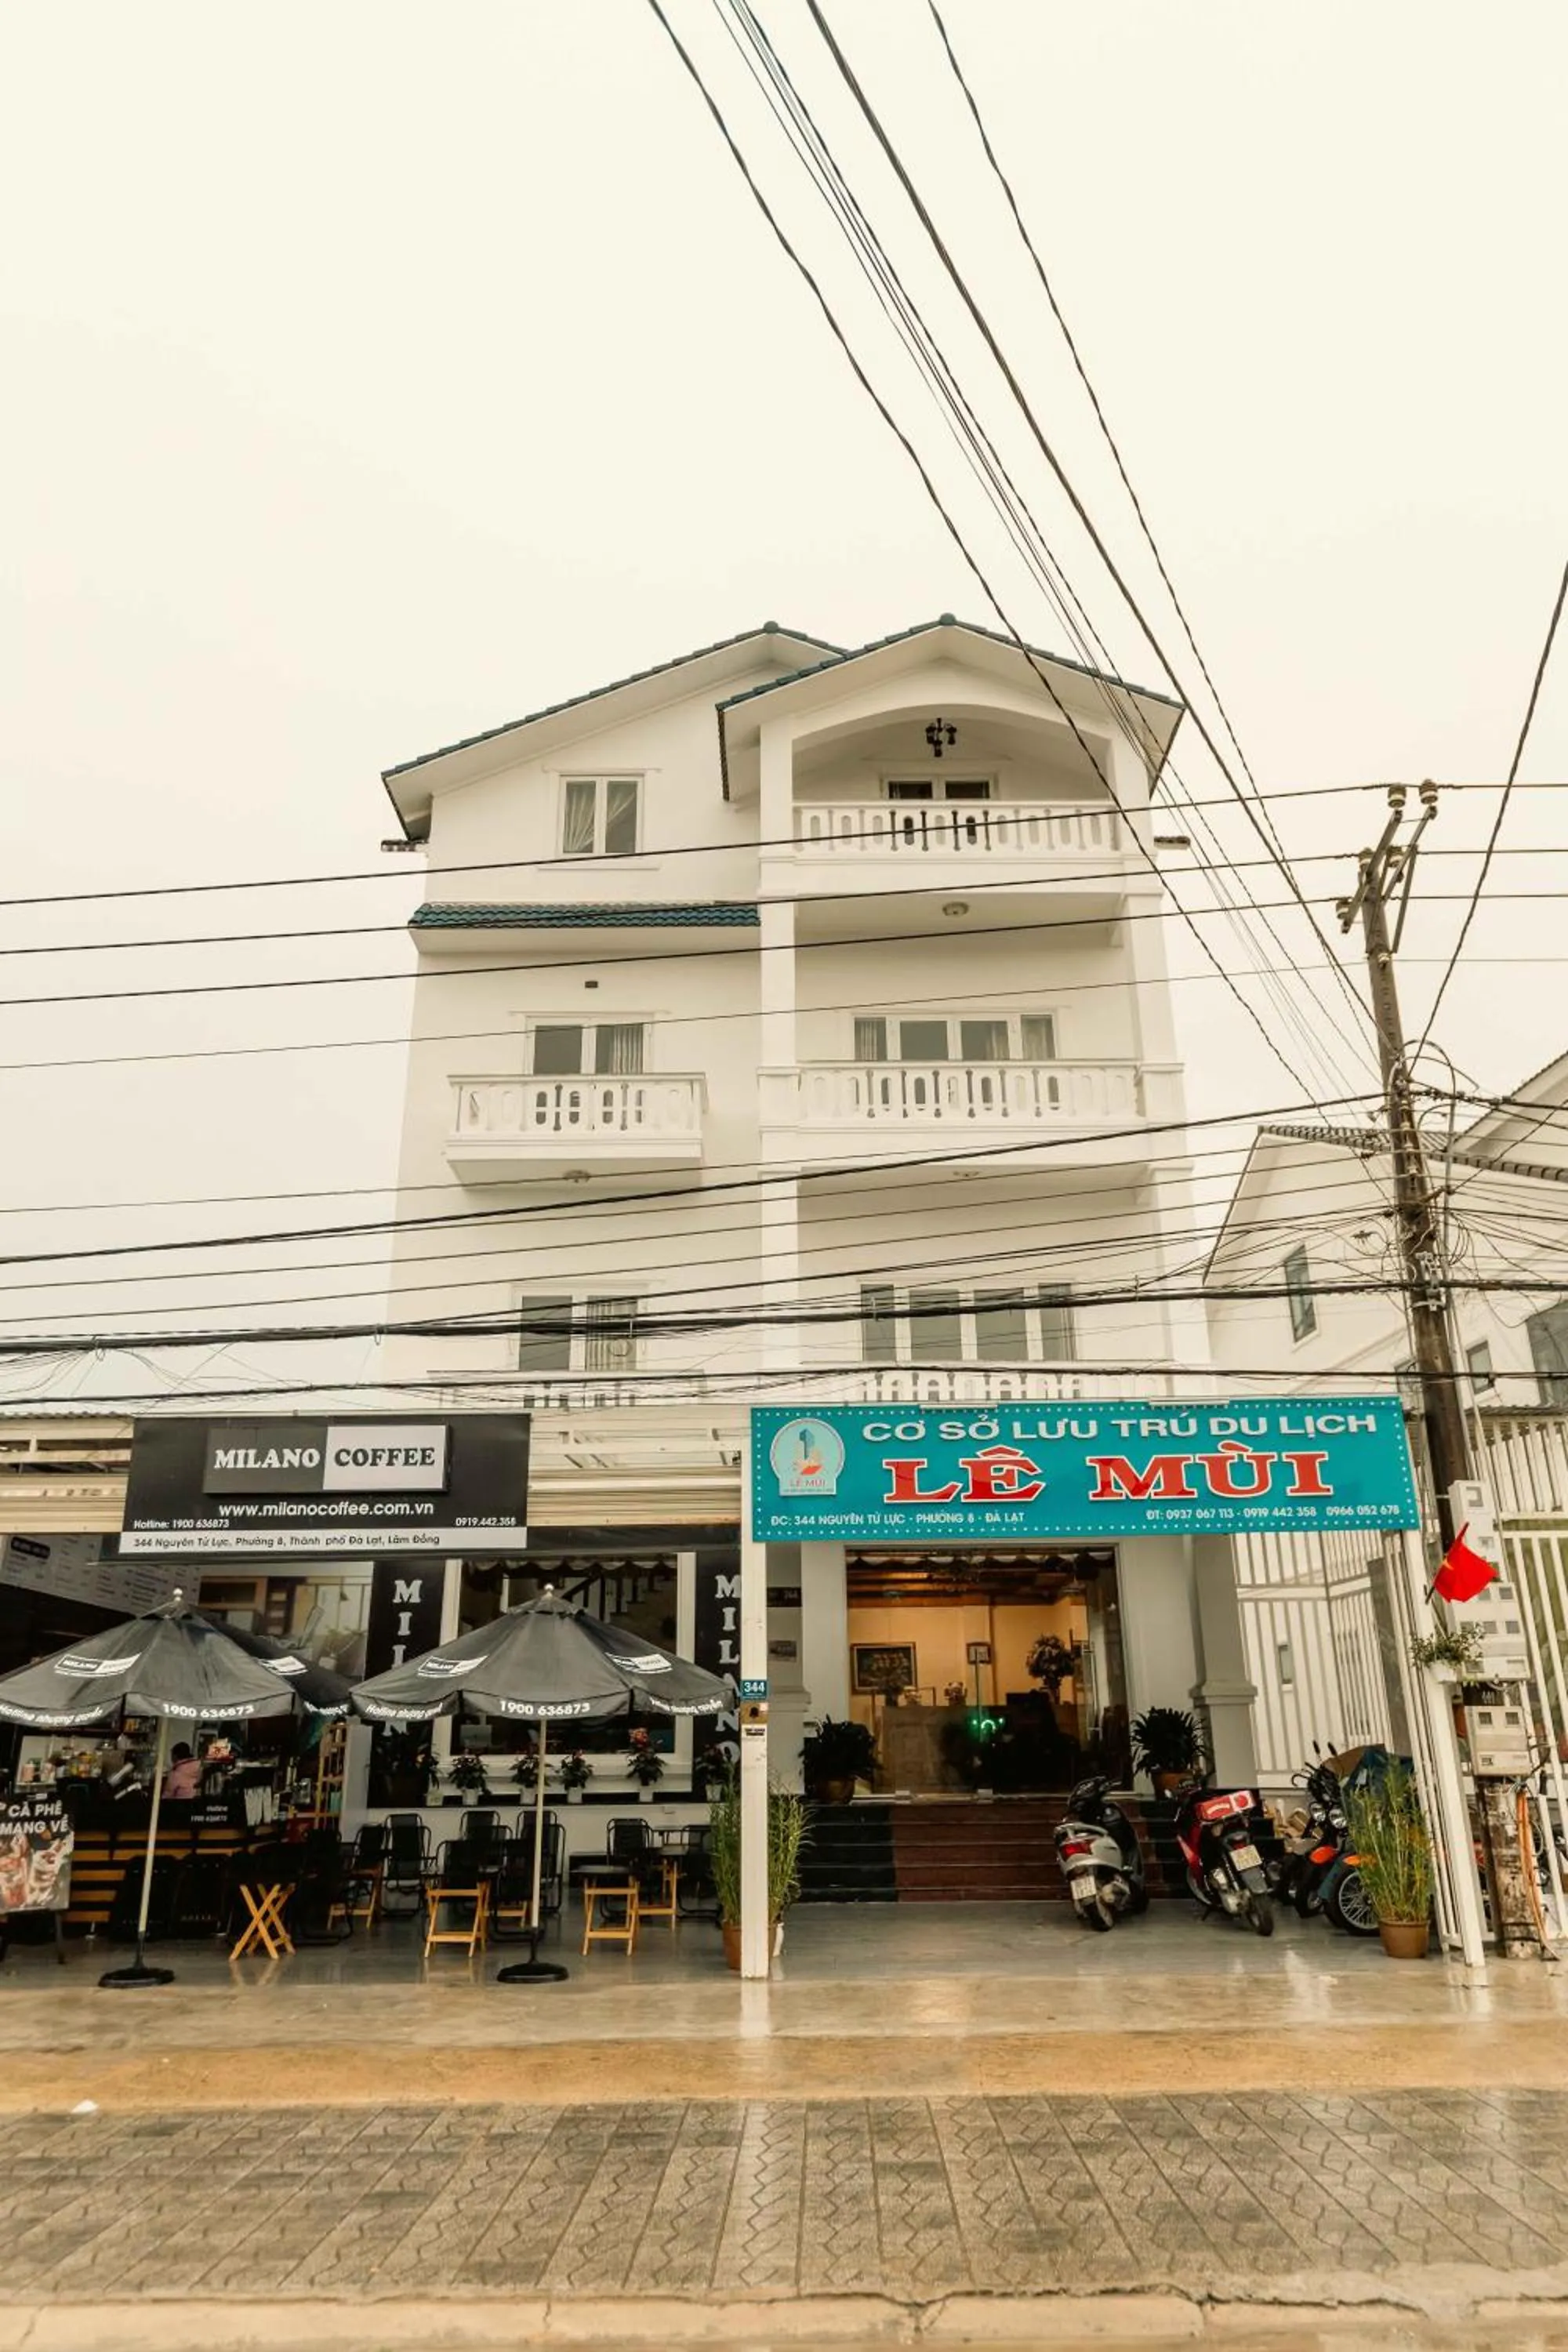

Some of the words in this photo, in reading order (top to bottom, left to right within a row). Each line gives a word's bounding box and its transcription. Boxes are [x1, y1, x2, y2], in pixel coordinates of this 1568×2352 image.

[862, 1420, 926, 1441] CƠ
[938, 1414, 1000, 1440] SỞ
[1012, 1417, 1098, 1439] LƯU
[1110, 1412, 1198, 1437] TRÚ
[1209, 1417, 1268, 1436] DU
[1279, 1414, 1377, 1439] LỊCH
[214, 1448, 320, 1469] MILANO
[335, 1447, 435, 1467] COFFEE
[882, 1445, 1047, 1503] LÊ
[1086, 1440, 1334, 1502] MÙI
[218, 1501, 434, 1517] www.milanocoffee.com.vn
[1166, 1508, 1192, 1520] 0937
[1196, 1508, 1215, 1519] 067
[1218, 1508, 1234, 1519] 113
[1243, 1507, 1269, 1518] 0919
[1272, 1507, 1293, 1516] 442
[1297, 1506, 1317, 1517] 358
[1326, 1505, 1354, 1515] 0966
[1357, 1504, 1377, 1515] 052
[1380, 1504, 1399, 1515] 678
[133, 1519, 169, 1529] Hotline:
[172, 1519, 194, 1529] 1900
[196, 1519, 230, 1528] 636873
[794, 1515, 815, 1525] 344
[744, 1682, 766, 1693] 344
[162, 1703, 197, 1718] 1900
[200, 1704, 255, 1719] 636873
[499, 1700, 534, 1715] 1900
[538, 1702, 591, 1717] 636873
[0, 1820, 47, 1835] MANG
